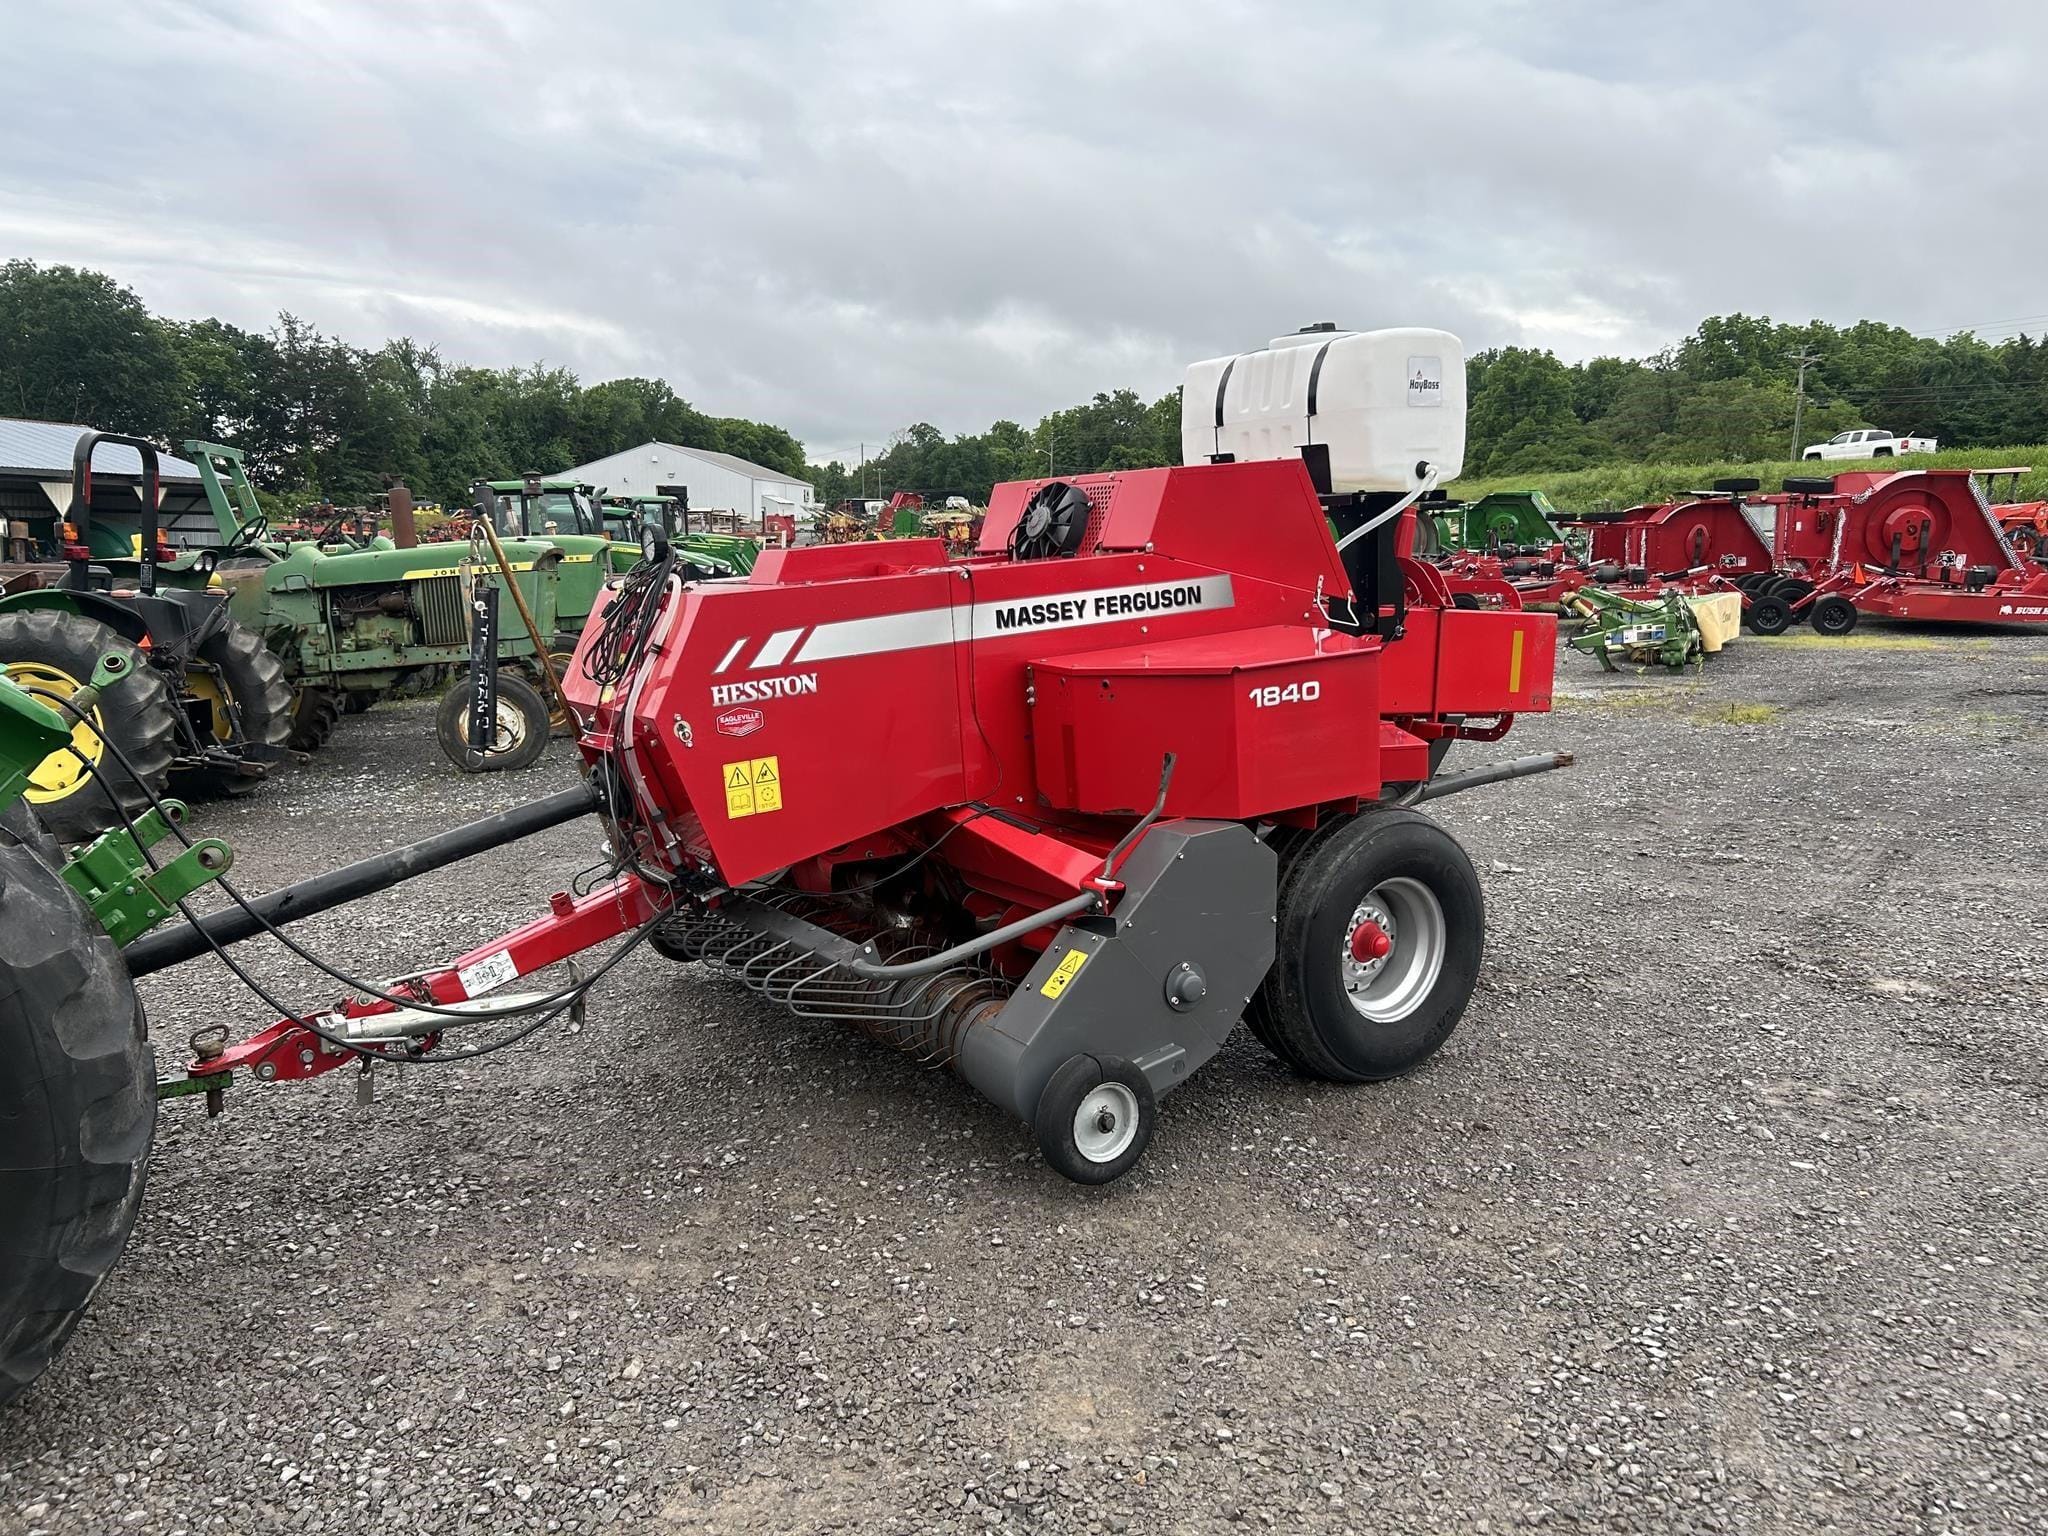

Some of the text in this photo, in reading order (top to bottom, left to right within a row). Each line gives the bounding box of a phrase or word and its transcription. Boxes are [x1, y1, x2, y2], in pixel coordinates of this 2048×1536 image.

[1409, 379, 1440, 393] HayBoss
[433, 569, 461, 577] JOH
[995, 585, 1202, 629] MASSEY FERGUSON
[2014, 606, 2043, 615] BUSH
[711, 673, 818, 707] HESSTON
[1249, 681, 1320, 708] 1840
[720, 712, 760, 723] EAGLEVILLE
